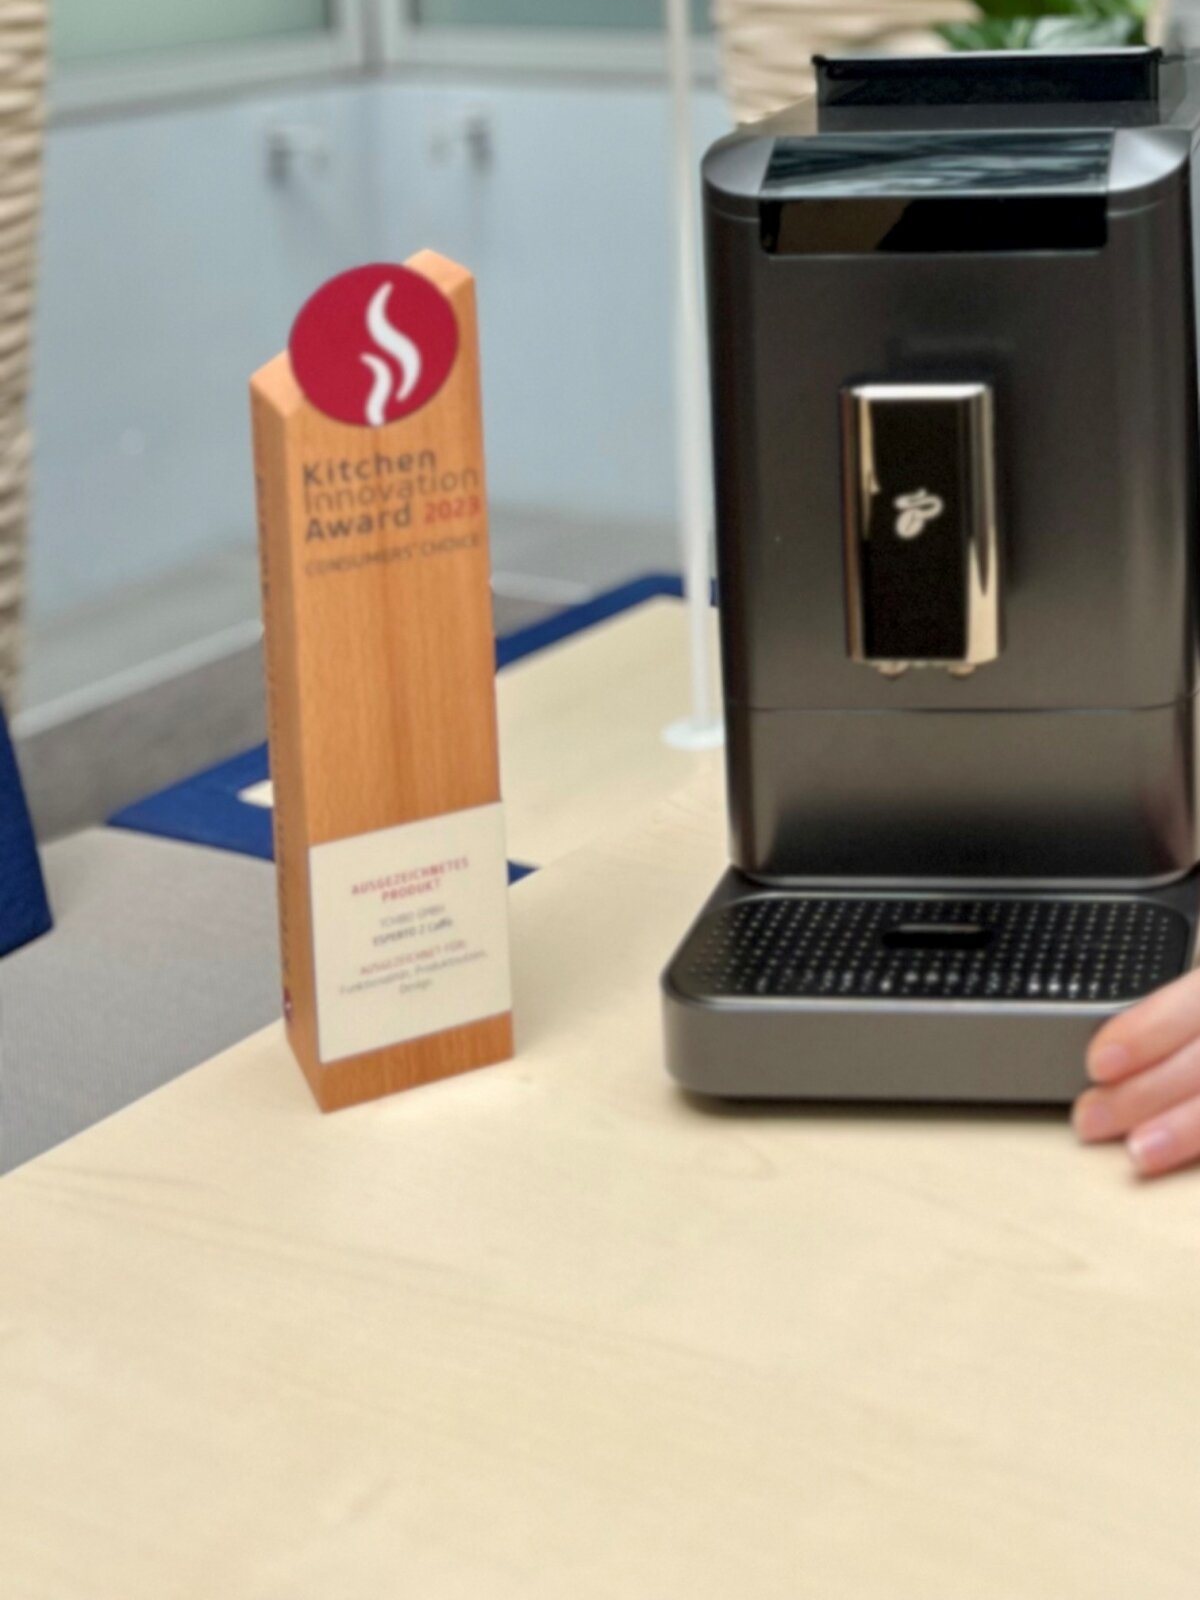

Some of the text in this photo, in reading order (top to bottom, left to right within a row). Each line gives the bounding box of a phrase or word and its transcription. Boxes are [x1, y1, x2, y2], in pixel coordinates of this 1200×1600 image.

[304, 450, 436, 486] Kitchen
[305, 468, 479, 513] Innovation
[306, 495, 481, 542] Award 2023
[382, 879, 441, 902] PRODUKT
